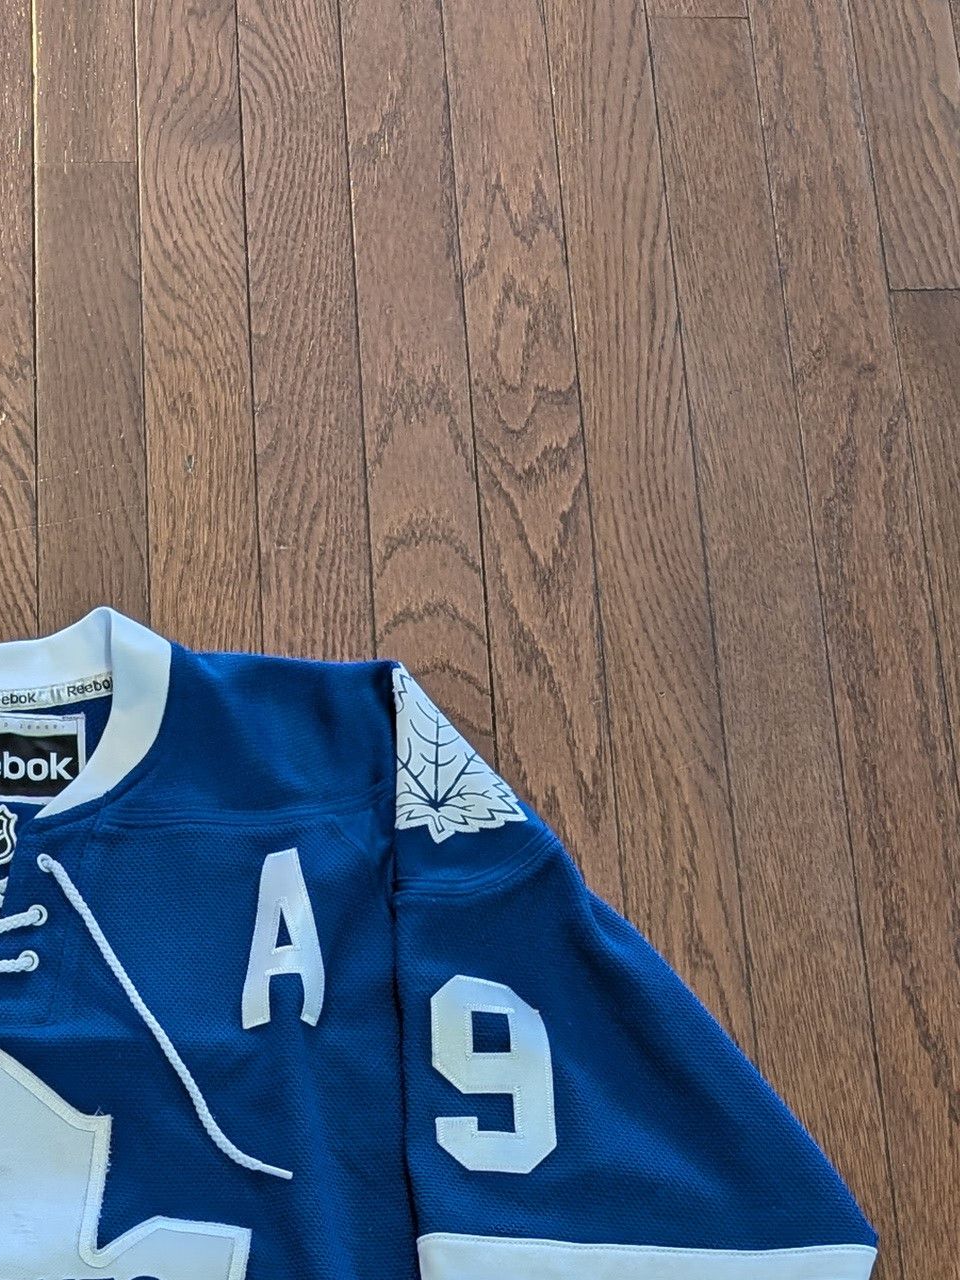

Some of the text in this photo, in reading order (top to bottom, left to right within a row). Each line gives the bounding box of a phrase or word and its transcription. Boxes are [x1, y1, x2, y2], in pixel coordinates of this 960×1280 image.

[67, 676, 113, 697] Reebo
[241, 847, 325, 1030] A
[430, 974, 557, 1174] 9
